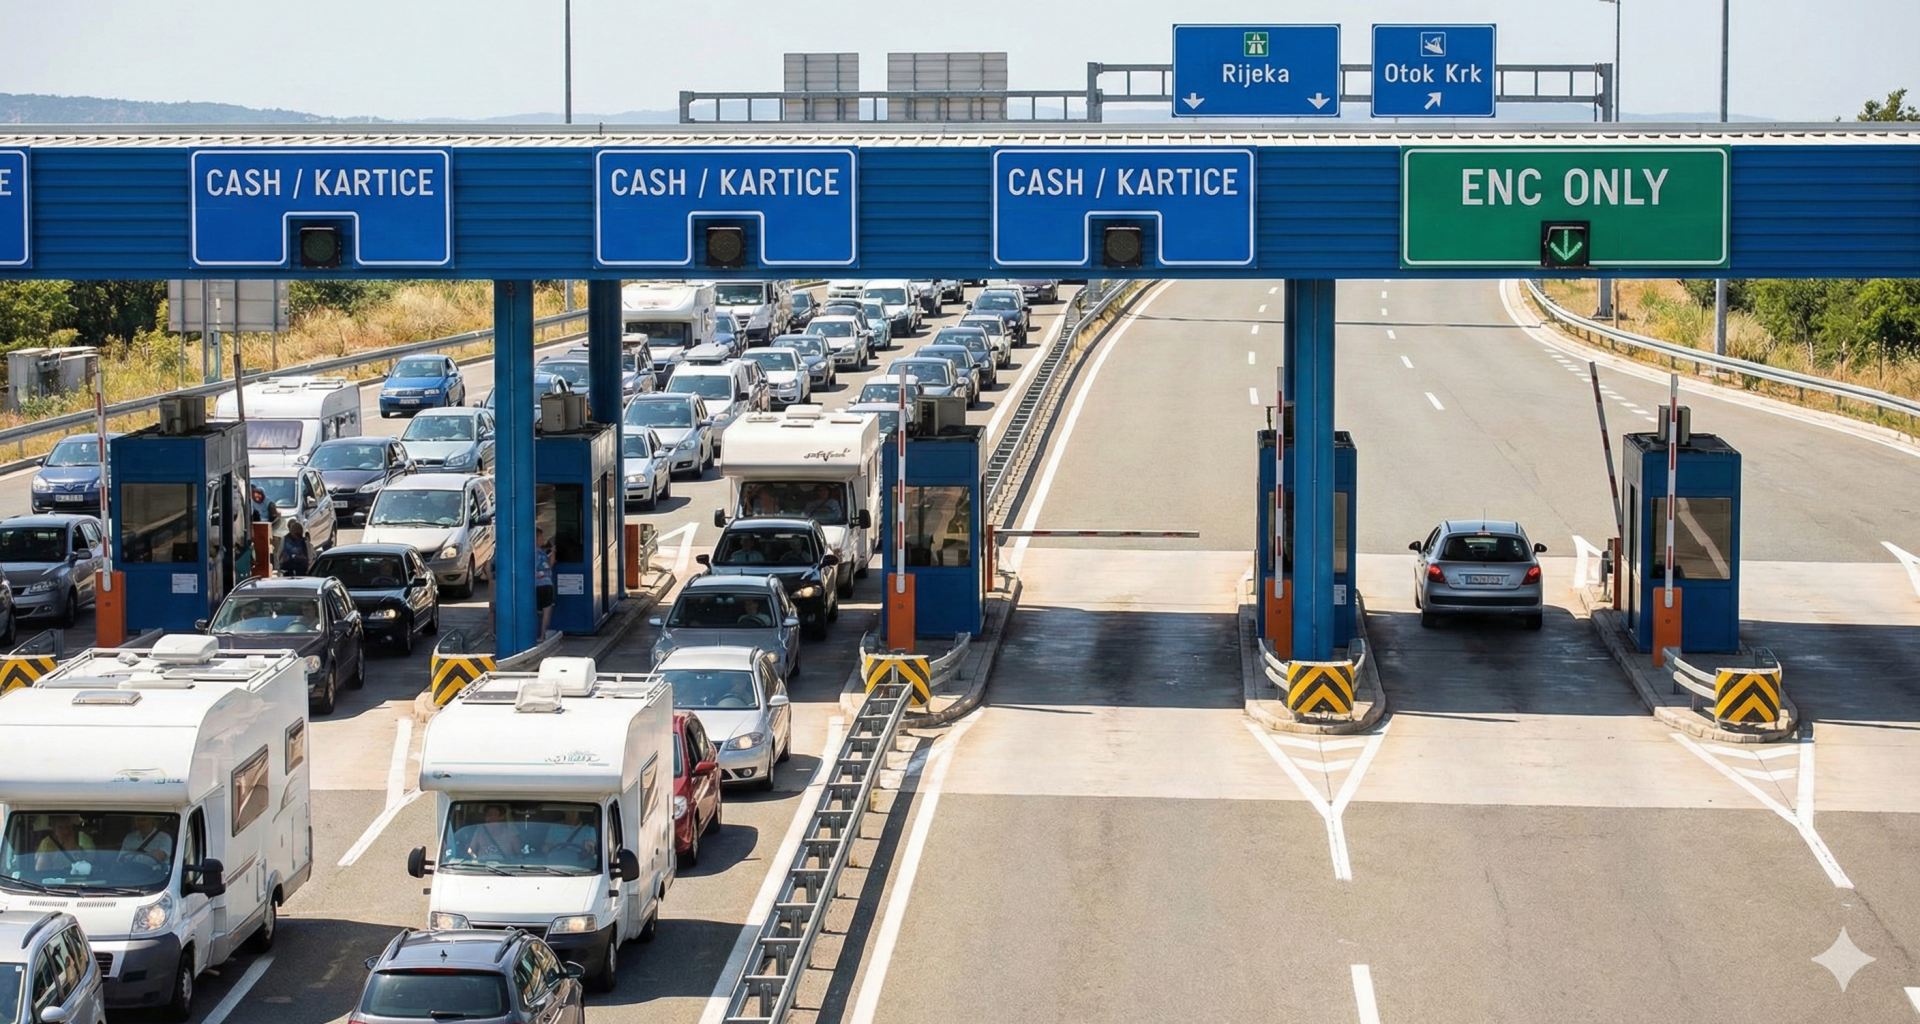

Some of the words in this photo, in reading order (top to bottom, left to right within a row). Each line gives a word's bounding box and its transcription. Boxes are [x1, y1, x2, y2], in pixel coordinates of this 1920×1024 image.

[1223, 63, 1290, 88] Rijeka
[1385, 63, 1434, 83] Otok
[1446, 63, 1482, 83] Krk
[207, 168, 280, 196] CASH
[293, 168, 303, 199] /
[315, 168, 434, 196] KARTICE
[611, 168, 686, 196] CASH
[698, 168, 708, 198] /
[720, 168, 839, 196] KARTICE
[1008, 168, 1083, 196] CASH
[1096, 168, 1106, 199] /
[1118, 168, 1238, 196] KARTICE
[1463, 168, 1541, 205] ENC
[1565, 168, 1669, 205] ONLY
